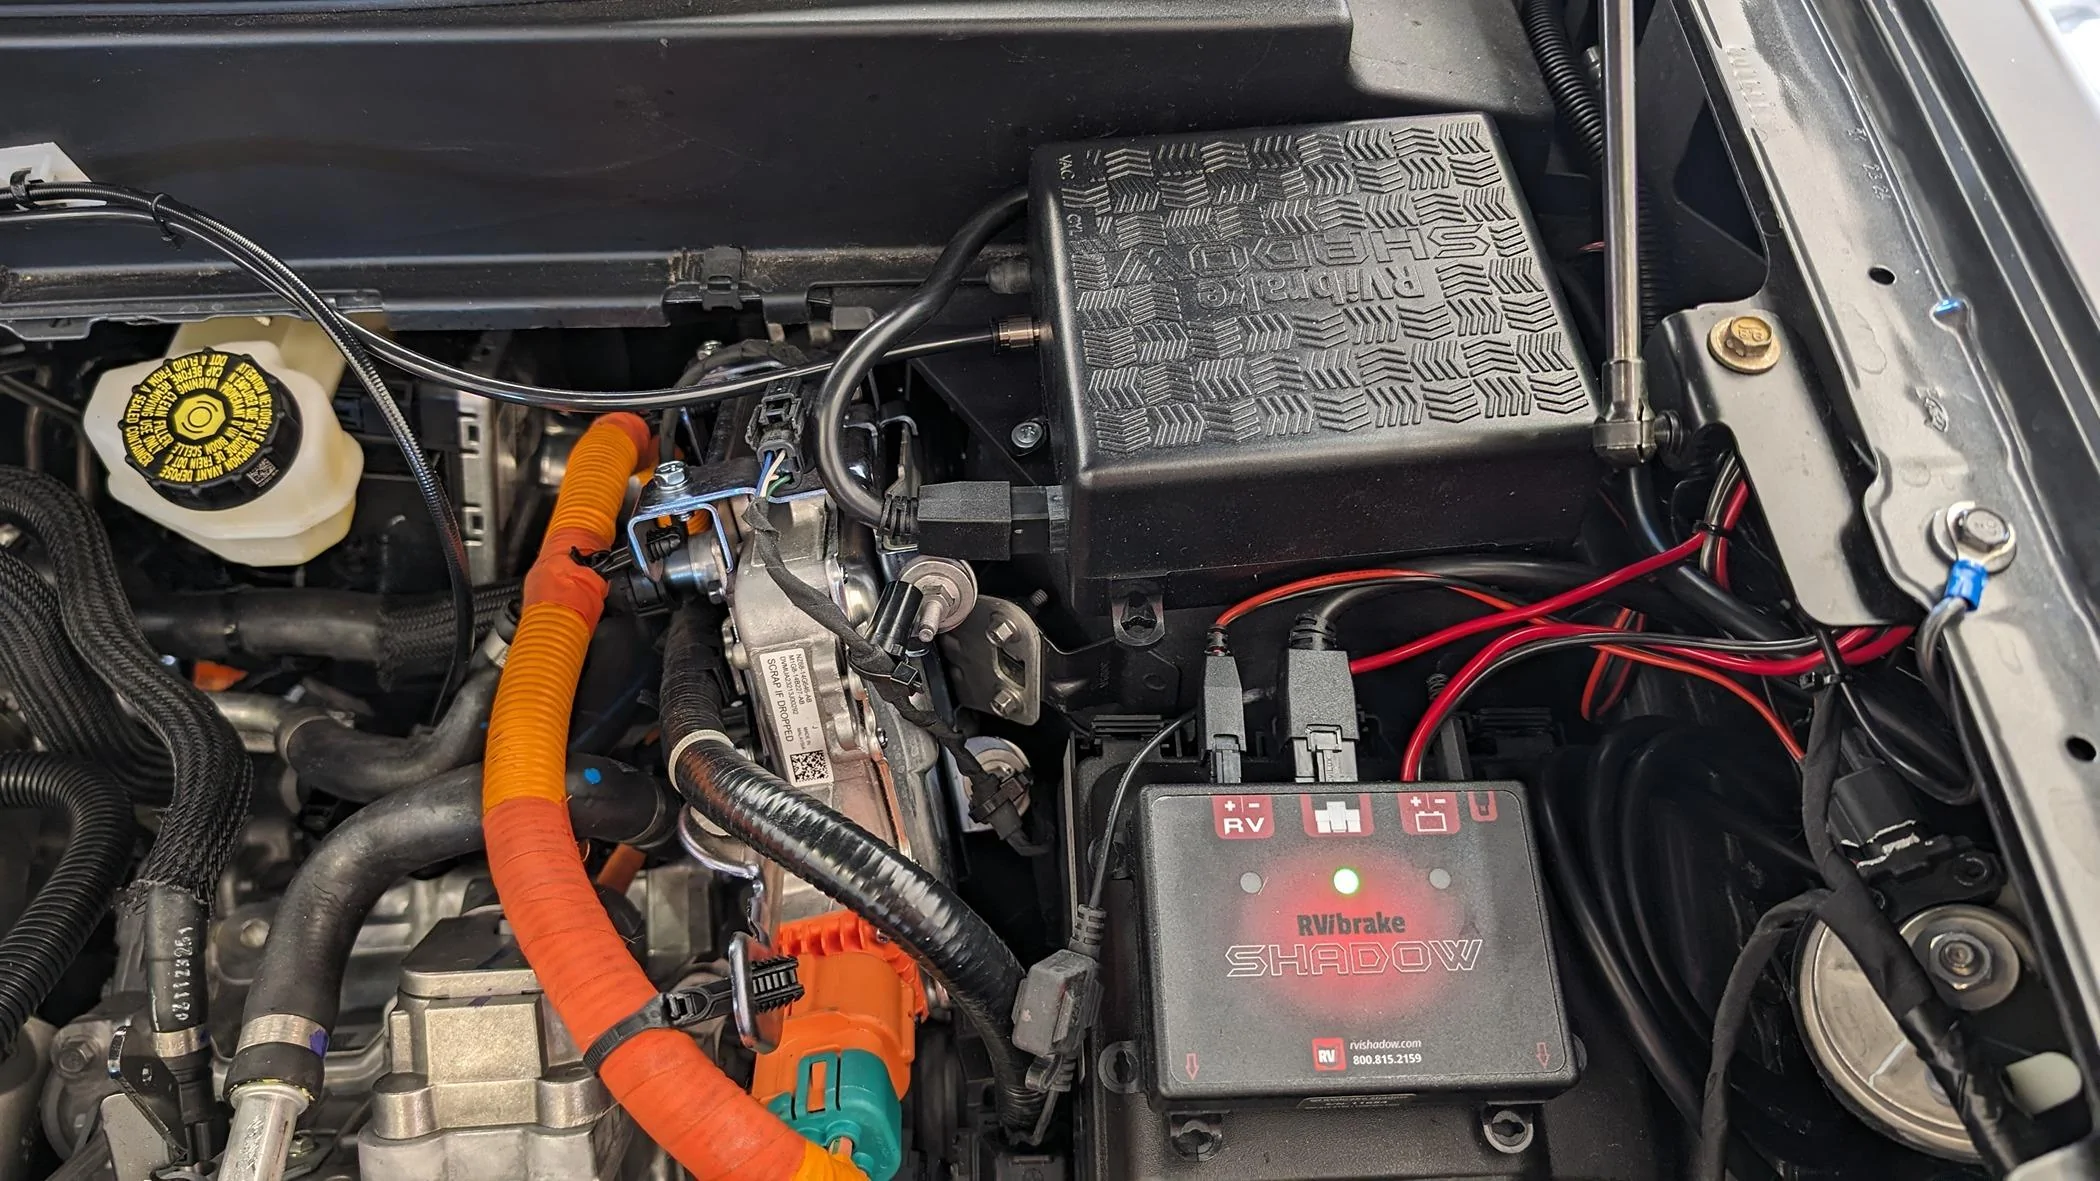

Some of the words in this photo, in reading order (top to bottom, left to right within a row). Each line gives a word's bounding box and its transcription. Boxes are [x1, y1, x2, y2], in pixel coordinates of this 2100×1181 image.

[1197, 262, 1424, 312] RVibrake
[173, 356, 199, 370] FLUID
[210, 355, 228, 366] DOT
[148, 366, 173, 385] FROM
[172, 366, 203, 385] BEFORE
[206, 367, 223, 378] CAP
[236, 363, 269, 393] ATTENTION
[142, 385, 151, 393] A
[178, 378, 218, 394] WARNING
[142, 381, 171, 415] REMOVING
[156, 392, 177, 417] CLEAN
[219, 382, 244, 418] PROVENANT
[126, 394, 145, 423] SEALED
[246, 408, 258, 421] QUE
[141, 419, 153, 435] USE
[155, 420, 174, 445] FILLER
[244, 422, 256, 432] DU
[146, 436, 163, 453] ONLY
[224, 431, 249, 454] LIQUIDE
[257, 431, 267, 442] LE
[126, 427, 154, 466] CONTAINER
[172, 443, 202, 457] SCELLE
[205, 439, 228, 455] BIDON
[172, 458, 189, 468] DOT
[190, 456, 212, 468] FREIN
[214, 451, 225, 463] DE
[226, 442, 259, 471] BOUCHON
[159, 467, 193, 481] DEPOSE
[196, 463, 223, 481] AVANT
[767, 658, 780, 688] SCRAP
[776, 701, 793, 742] DROPPED
[1224, 817, 1264, 835] RV
[1297, 912, 1406, 936] RVibrake
[1225, 939, 1483, 977] SHADOW
[1350, 1040, 1421, 1050] rvishadow.com
[1318, 1049, 1335, 1062] RV
[1353, 1053, 1421, 1065] 800.815.2159
